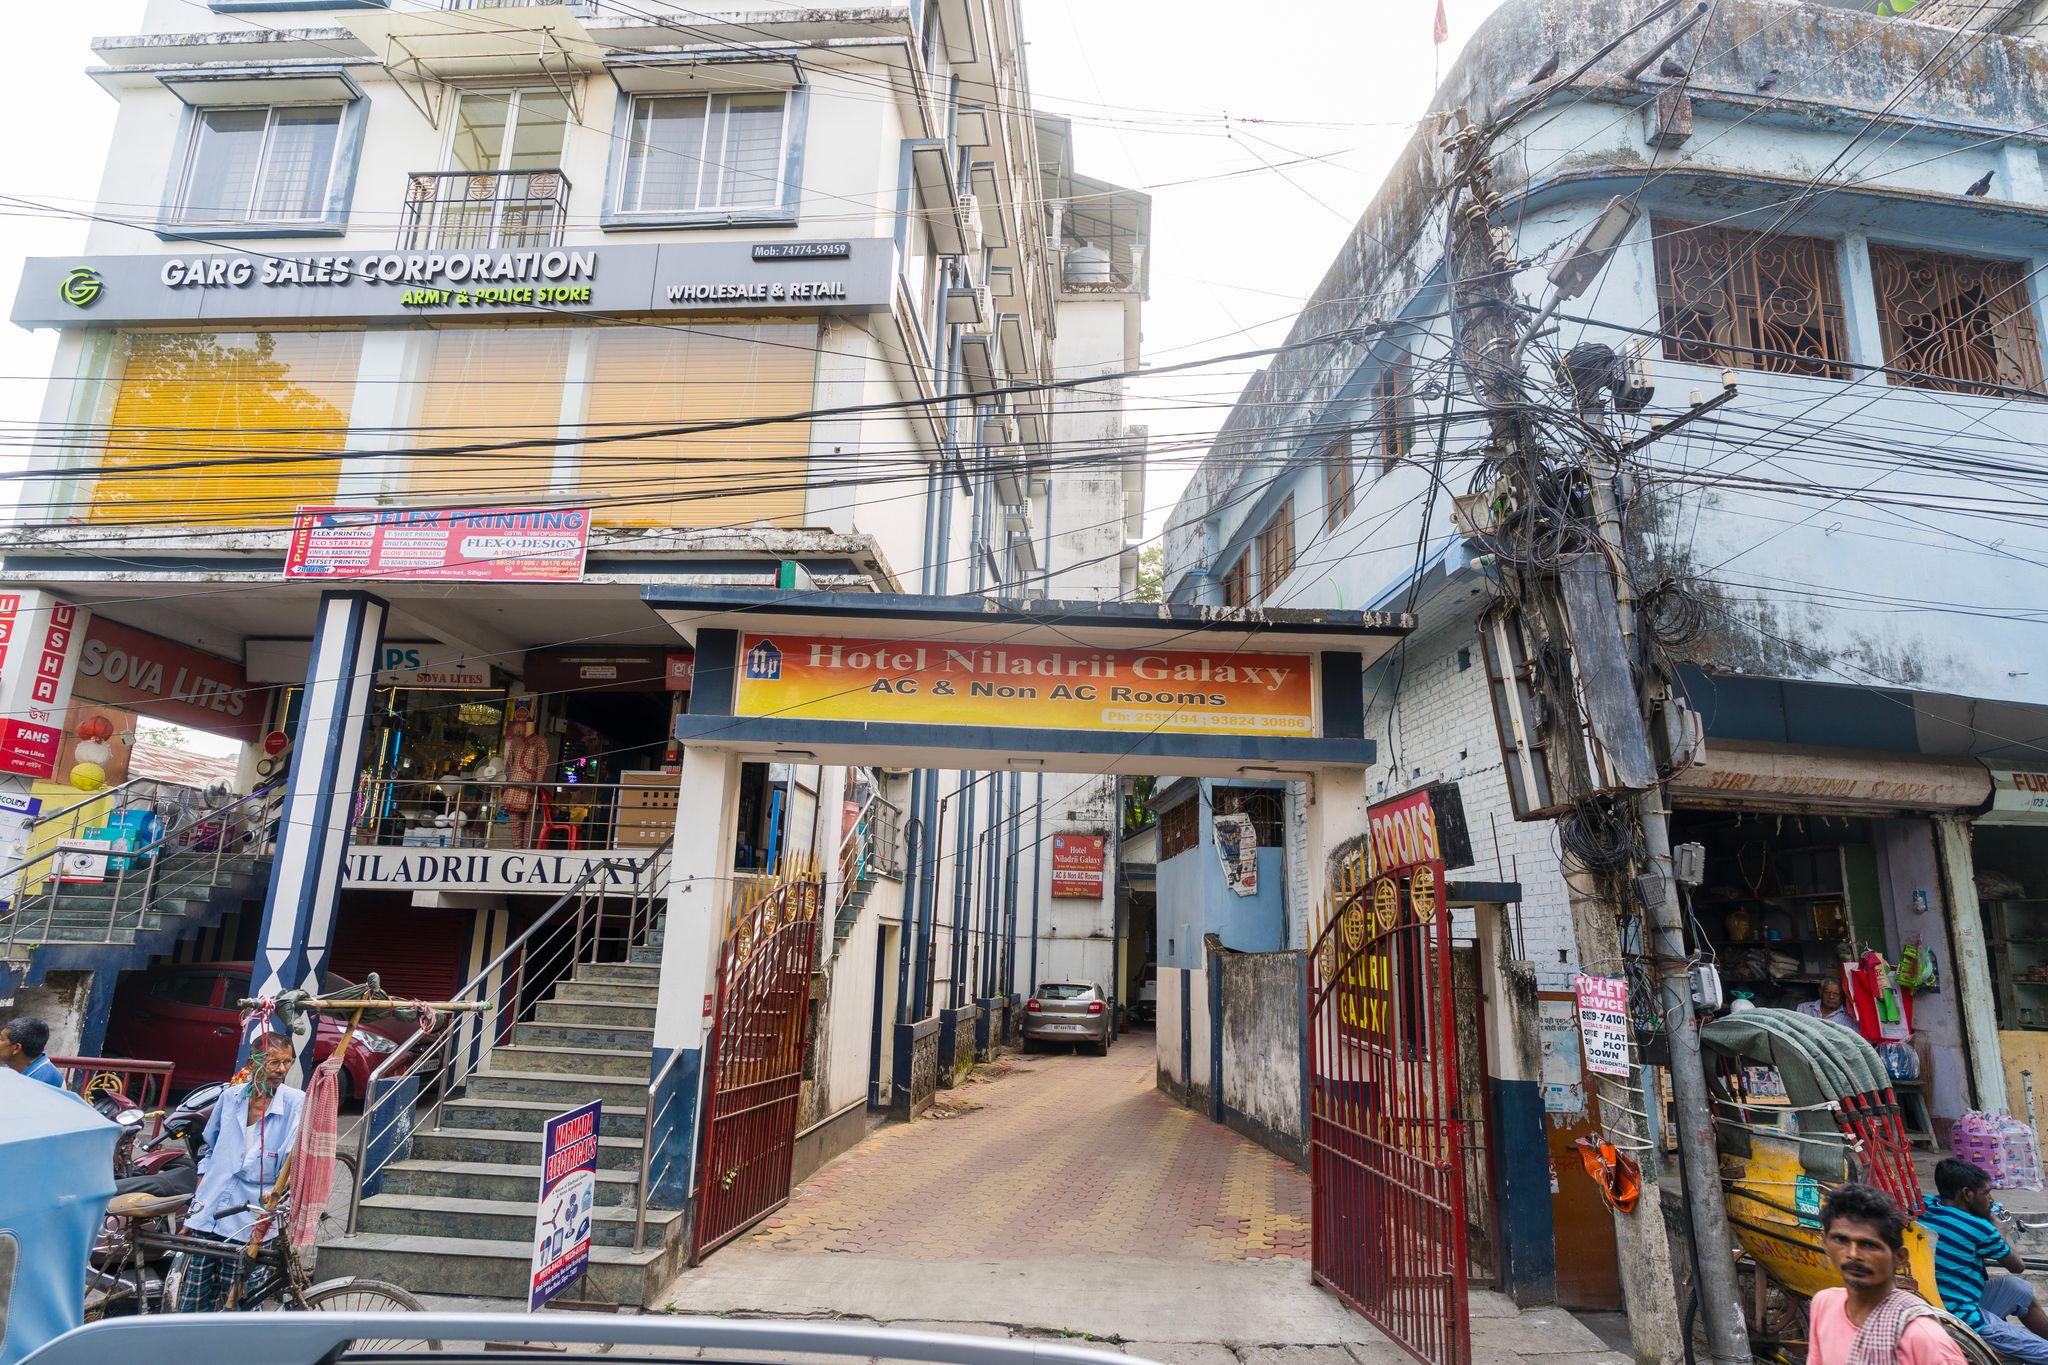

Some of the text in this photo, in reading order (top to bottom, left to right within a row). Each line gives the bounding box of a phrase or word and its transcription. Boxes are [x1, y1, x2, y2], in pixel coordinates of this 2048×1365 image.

[754, 244, 846, 257] Mob: 74774-59459
[160, 251, 597, 288] GARG SALES CORPORATION
[400, 284, 592, 306] ARMY & POLICE STORE
[667, 281, 846, 300] WHOLESALE & RETAIL
[380, 511, 583, 530] FLEX PRINTING
[294, 514, 312, 562] Printing
[467, 539, 577, 549] FLEX-O-DESIGN
[467, 569, 490, 577] Siliguri
[38, 605, 71, 699] USHA
[807, 643, 1292, 692] Hotel Niladrii Galaxy
[78, 639, 247, 717] SOVA LITES
[416, 673, 483, 684] SOVA LITES
[870, 678, 1227, 707] AC & Non AC Rooms
[1107, 711, 1130, 722] Ph:
[1211, 714, 1256, 726] 93824
[1260, 715, 1305, 728] 30886
[17, 728, 50, 744] FANS
[14, 747, 45, 758] Sova Lites
[2012, 773, 2048, 792] FUR
[1372, 802, 1435, 868] ROOMS
[1069, 846, 1087, 854] Hotel
[501, 855, 651, 885] GALAXY
[1055, 855, 1101, 866] Niladrii Galaxy
[1577, 976, 1624, 998] TO-LET
[1581, 995, 1624, 1011] SERVICE
[1603, 1041, 1627, 1052] PLOT
[1605, 1032, 1626, 1042] FLAT
[1600, 1060, 1628, 1069] RESIDENTIAL
[555, 1111, 593, 1152] NARMADA
[546, 1134, 597, 1184] ELECTRICAL'S
